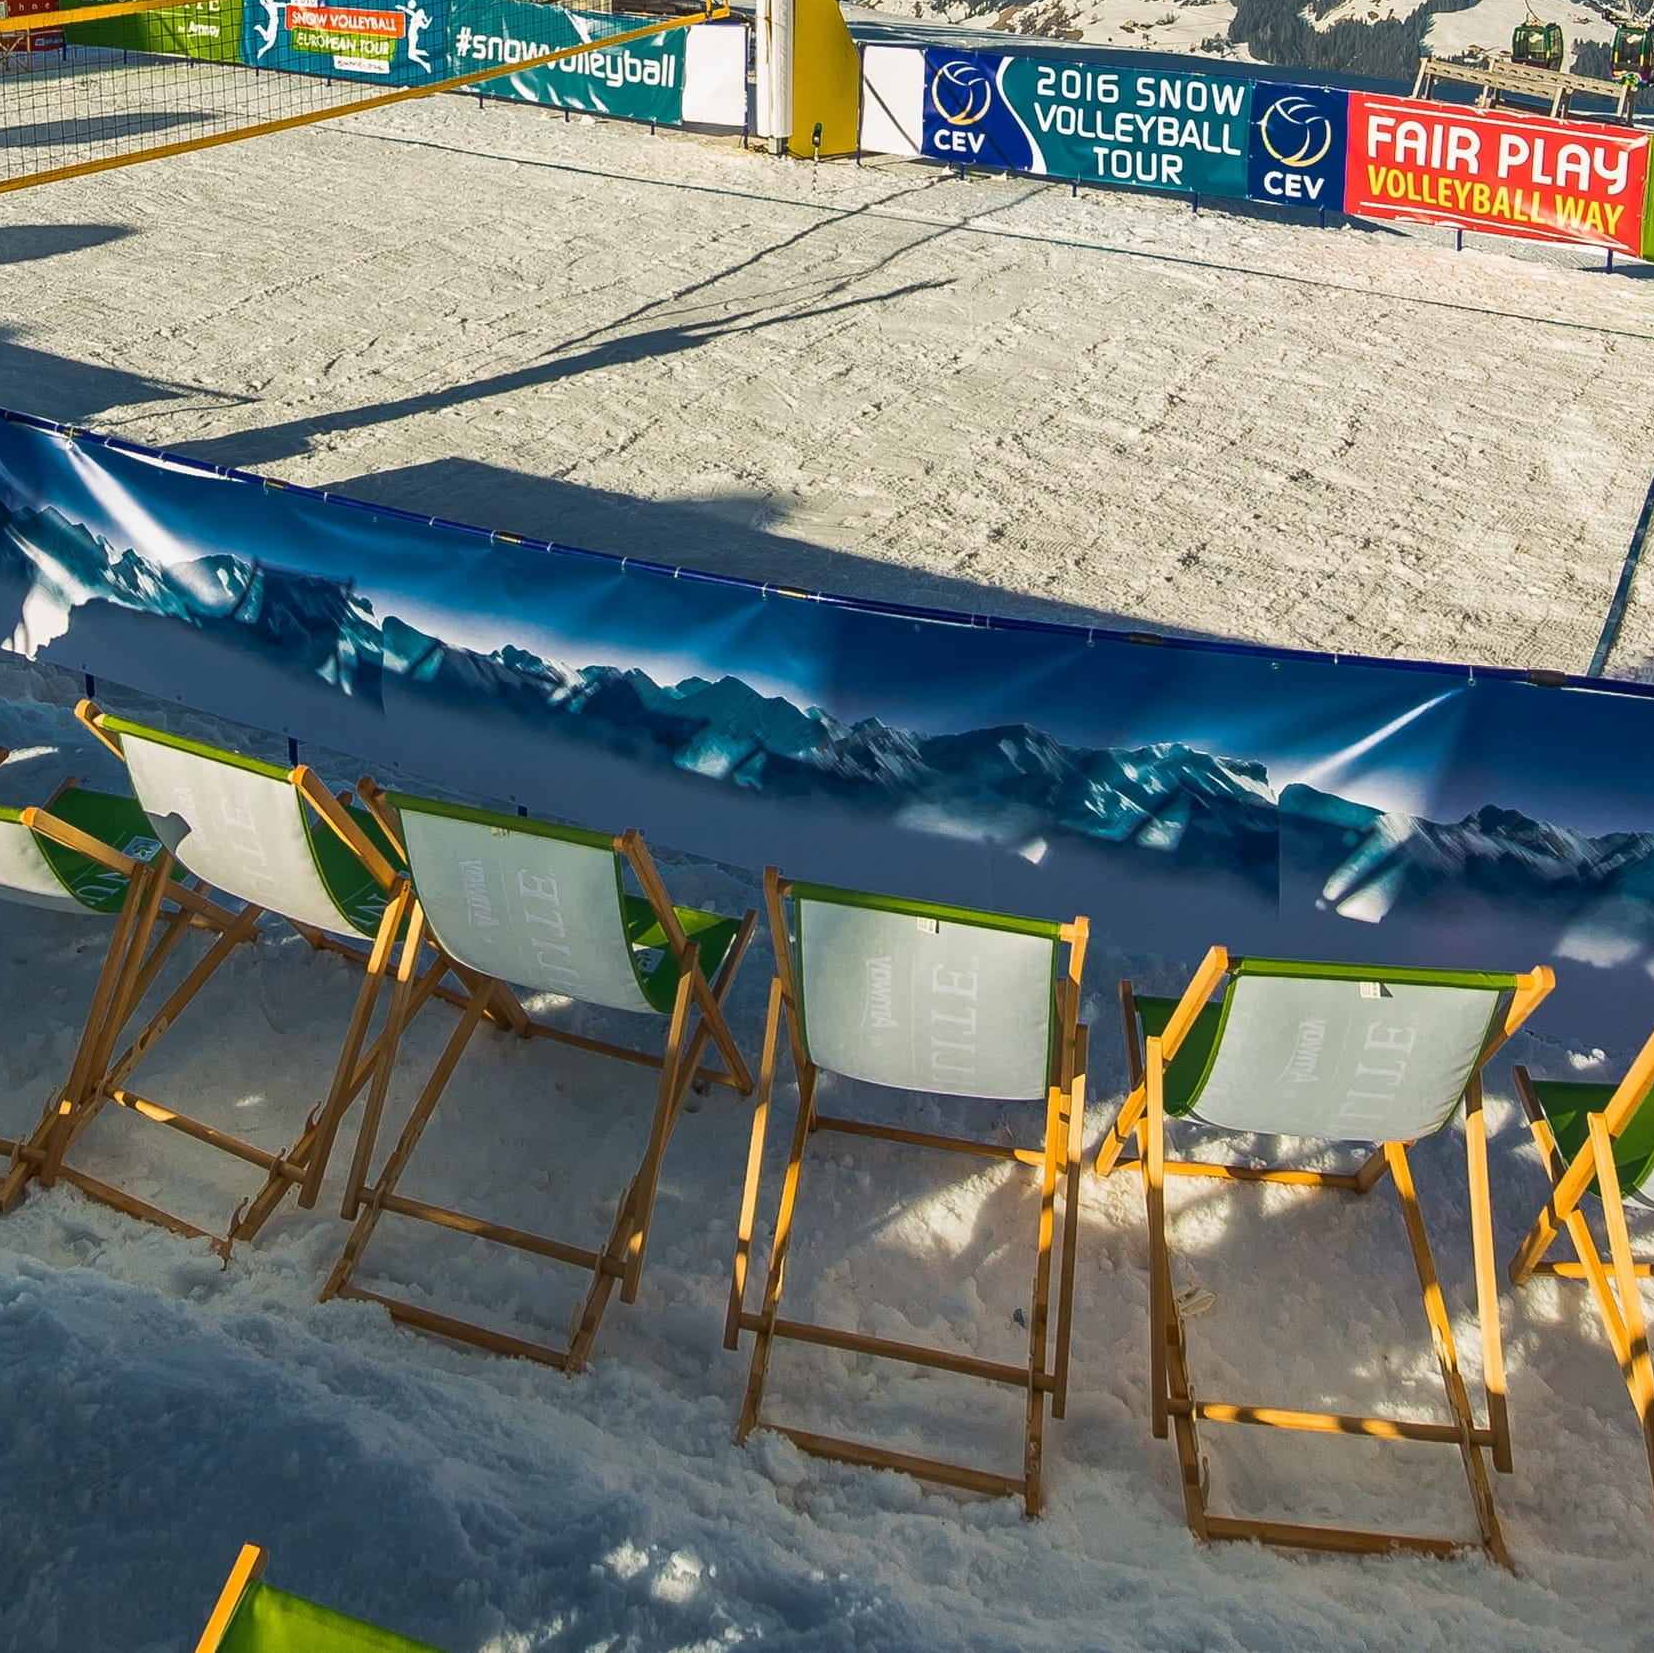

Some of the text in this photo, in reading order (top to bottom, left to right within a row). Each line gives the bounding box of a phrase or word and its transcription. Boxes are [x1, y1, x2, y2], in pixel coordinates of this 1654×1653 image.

[291, 11, 397, 32] SNOW VOLLEYBALL
[297, 32, 390, 55] EUROPEAN TOUR
[455, 26, 676, 89] #snowvolleyball
[1035, 66, 1245, 117] 2016 SNOW
[933, 129, 986, 154] CEV
[1033, 101, 1242, 157] VOLLEYBALL
[1092, 147, 1184, 185] TOUR
[1366, 114, 1630, 195] FAIR PLAY
[1263, 171, 1325, 201] CEV
[1367, 163, 1625, 235] VOLLEYBALL WAY
